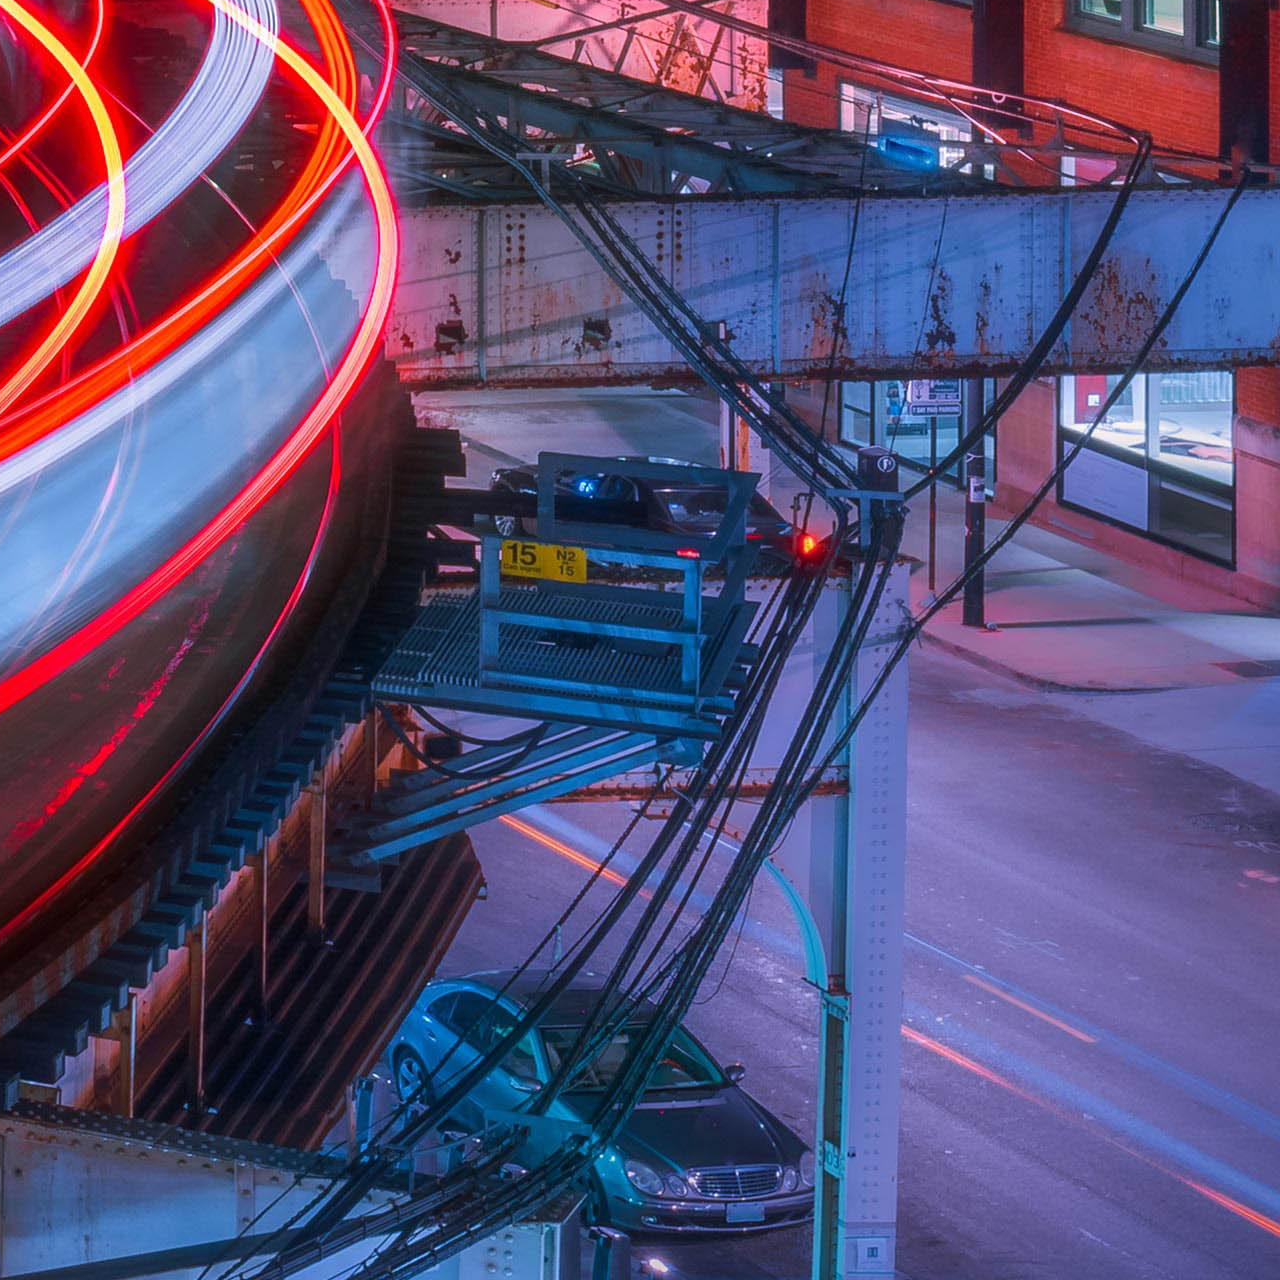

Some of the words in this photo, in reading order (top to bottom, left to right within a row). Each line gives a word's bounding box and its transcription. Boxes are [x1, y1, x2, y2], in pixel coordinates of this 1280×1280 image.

[506, 542, 537, 566] 15
[556, 549, 576, 562] N2
[558, 564, 576, 577] 15
